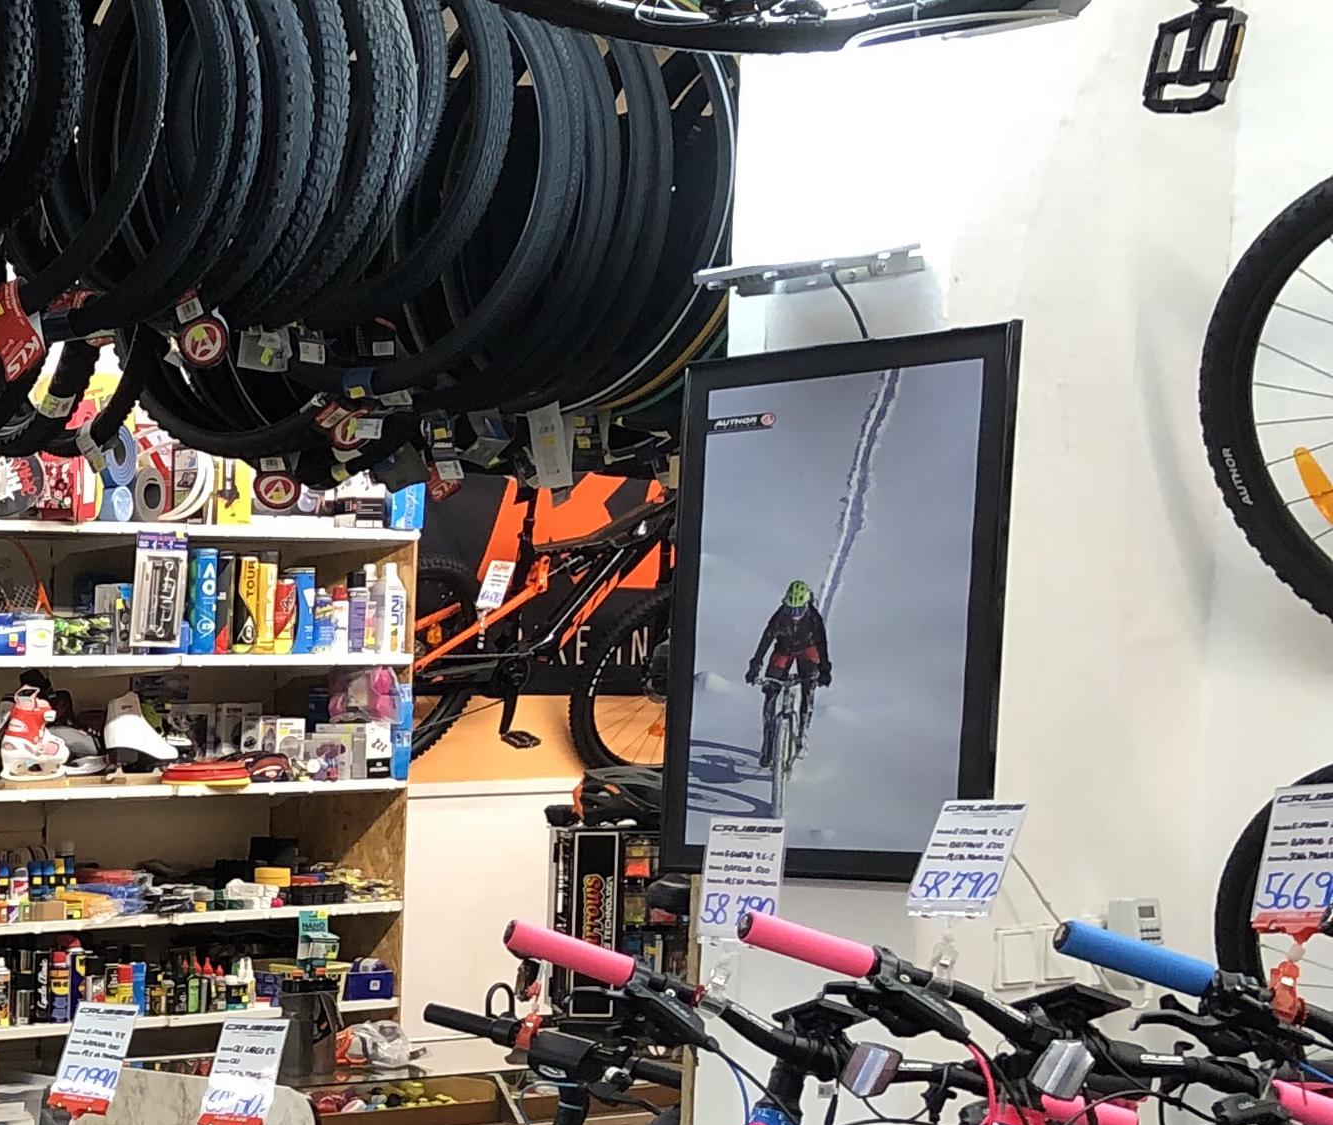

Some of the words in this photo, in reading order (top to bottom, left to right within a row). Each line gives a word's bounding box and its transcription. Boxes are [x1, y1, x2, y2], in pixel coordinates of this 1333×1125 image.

[714, 416, 758, 429] AUTHOR
[1221, 446, 1253, 507] AUTHOR
[246, 559, 257, 598] TOUR
[944, 802, 1026, 812] CRUSSIS
[712, 824, 784, 835] CRUSSIS
[224, 1023, 287, 1032] CRUSSIS
